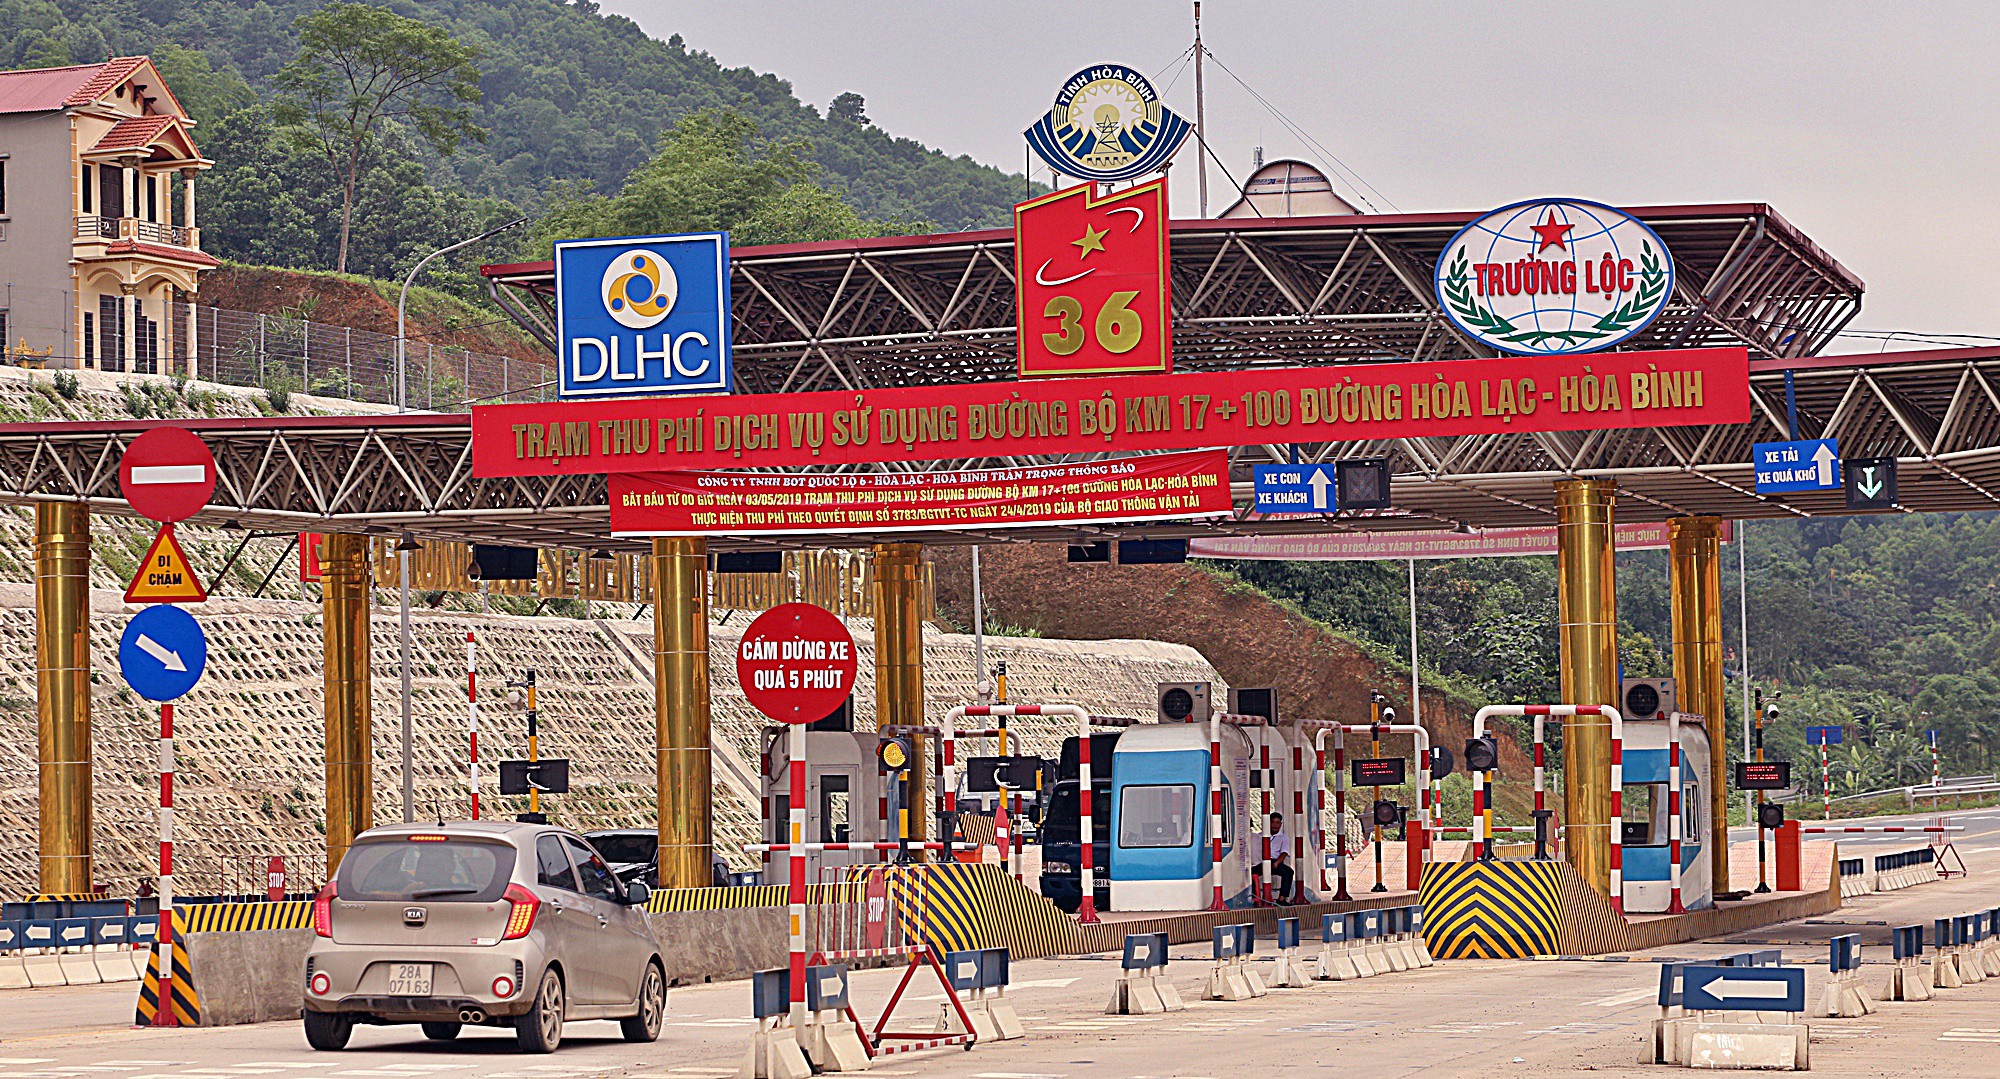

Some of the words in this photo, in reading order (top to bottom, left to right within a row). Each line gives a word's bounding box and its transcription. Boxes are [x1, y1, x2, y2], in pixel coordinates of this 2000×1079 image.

[1091, 66, 1123, 80] HÒA
[1126, 73, 1154, 102] BÌNH
[1473, 253, 1576, 296] TRƯỜNG
[1586, 252, 1634, 300] LỘC
[1042, 290, 1140, 356] 36
[572, 331, 710, 382] DLHC
[512, 421, 589, 465] TRẠM
[598, 418, 650, 455] THU
[657, 408, 704, 453] PHÍ
[714, 413, 778, 458] DỊCH
[788, 412, 825, 456] VỤ
[832, 395, 873, 446] SỬ
[879, 407, 958, 450] DỤNG
[968, 391, 1068, 440] ĐƯỜNG
[1080, 389, 1117, 441] BỘ
[1125, 395, 1170, 434] KM
[1299, 375, 1402, 424] ĐƯỜNG
[1411, 373, 1471, 419] HÒA
[1630, 363, 1704, 409] BÌNH
[1765, 451, 1779, 463] XE
[1781, 447, 1798, 462] TẢI
[697, 475, 729, 486] CÔNG
[731, 478, 746, 486] TY
[749, 478, 780, 486] TNHH
[783, 478, 806, 486] BOT
[859, 477, 866, 485] 6
[902, 475, 924, 487] LẠC
[990, 469, 1023, 481] TRÂN
[1026, 468, 1065, 480] TRỌNG
[1068, 464, 1108, 475] THÔNG
[1111, 462, 1135, 474] BÁO
[1264, 473, 1277, 485] XE
[1280, 472, 1300, 484] CON
[1757, 472, 1771, 484] XE
[1772, 468, 1793, 483] QUÁ
[622, 490, 641, 506] BẮT
[644, 490, 665, 506] ĐẦU
[666, 491, 680, 506] TỪ
[698, 492, 714, 506] GIỜ
[716, 492, 743, 506] NGÀY
[745, 493, 802, 505] 03/05/2019
[804, 492, 833, 506] TRẠM
[835, 492, 854, 504] THU
[857, 490, 875, 504] PHÍ
[877, 490, 901, 505] DỊCH
[904, 490, 917, 504] VỤ
[937, 488, 964, 504] DỤNG
[968, 484, 1002, 500] ĐƯỜNG
[1005, 484, 1020, 500] BỘ
[1022, 485, 1038, 498] KM
[1192, 472, 1218, 487] BÌNH
[1258, 492, 1271, 504] XE
[1274, 490, 1308, 504] KHÁCH
[691, 511, 717, 527] THỰC
[720, 510, 743, 527] HIỆN
[745, 512, 764, 524] THU
[767, 510, 785, 524] PHÍ
[787, 511, 812, 524] THEO
[815, 507, 845, 524] QUYẾT
[848, 510, 874, 524] ĐỊNH
[876, 506, 890, 521] SỐ
[892, 507, 968, 521] 3783/BGTVT-TC
[970, 504, 997, 518] NGÀY
[1001, 502, 1050, 517] 24/4/2019
[1054, 497, 1075, 514] CỦA
[1078, 499, 1092, 515] BỘ
[1094, 499, 1118, 512] GIAO
[1121, 496, 1156, 511] THÔNG
[1159, 495, 1180, 512] VẬN
[1182, 490, 1200, 508] TẢI
[158, 555, 170, 567] ĐI
[149, 570, 182, 588] CHẬM
[742, 634, 778, 660] CẤM
[782, 635, 825, 660] DỪNG
[828, 641, 849, 660] XE
[754, 664, 785, 691] QUÁ
[789, 670, 799, 689] 5
[803, 664, 843, 689] PHÚT
[268, 872, 285, 889] STOP
[868, 897, 885, 922] STOP
[400, 966, 421, 979] 28A
[389, 980, 430, 993] 071.63
